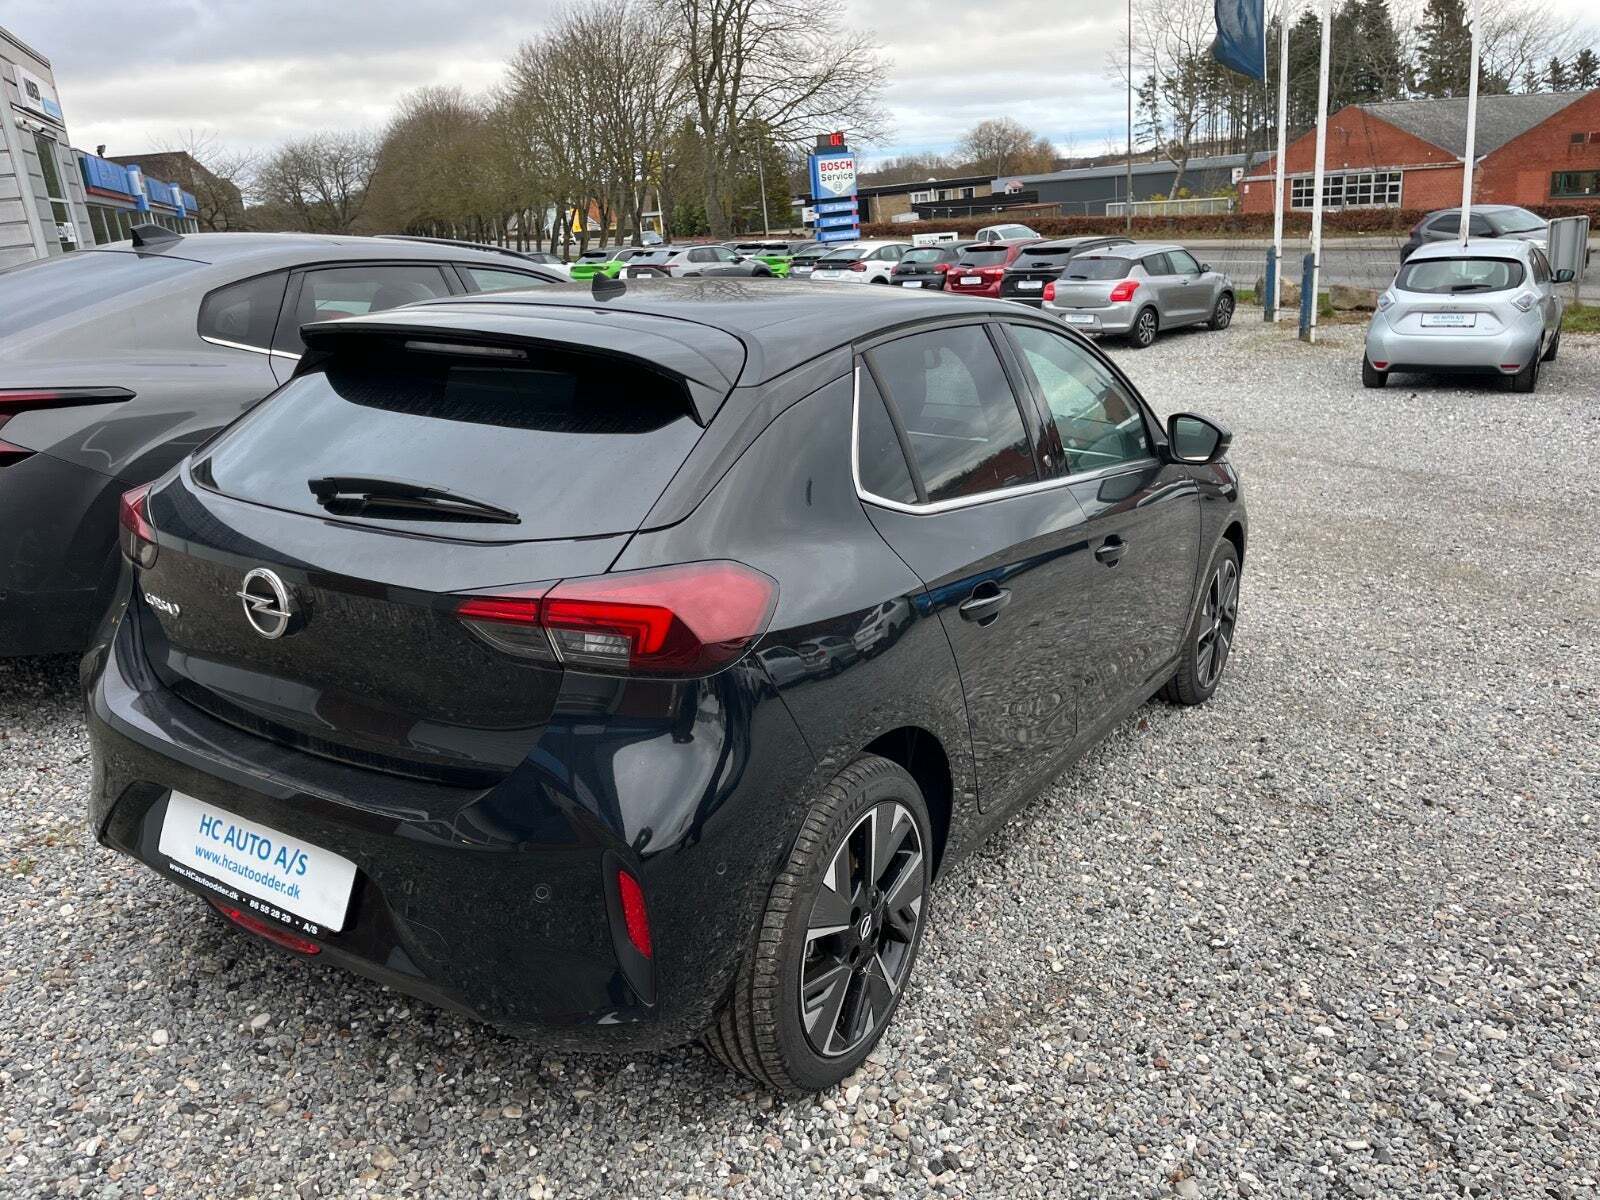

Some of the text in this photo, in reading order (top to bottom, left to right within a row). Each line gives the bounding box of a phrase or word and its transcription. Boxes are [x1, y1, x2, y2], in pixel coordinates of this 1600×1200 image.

[820, 161, 853, 171] BOSCH
[821, 172, 853, 182] Service
[199, 813, 308, 876] HC AUTO A/S
[169, 863, 318, 934] www.HCautoodder.dk 86 55 28 29 A/S
[195, 845, 301, 899] www.hcautoodder.dk
